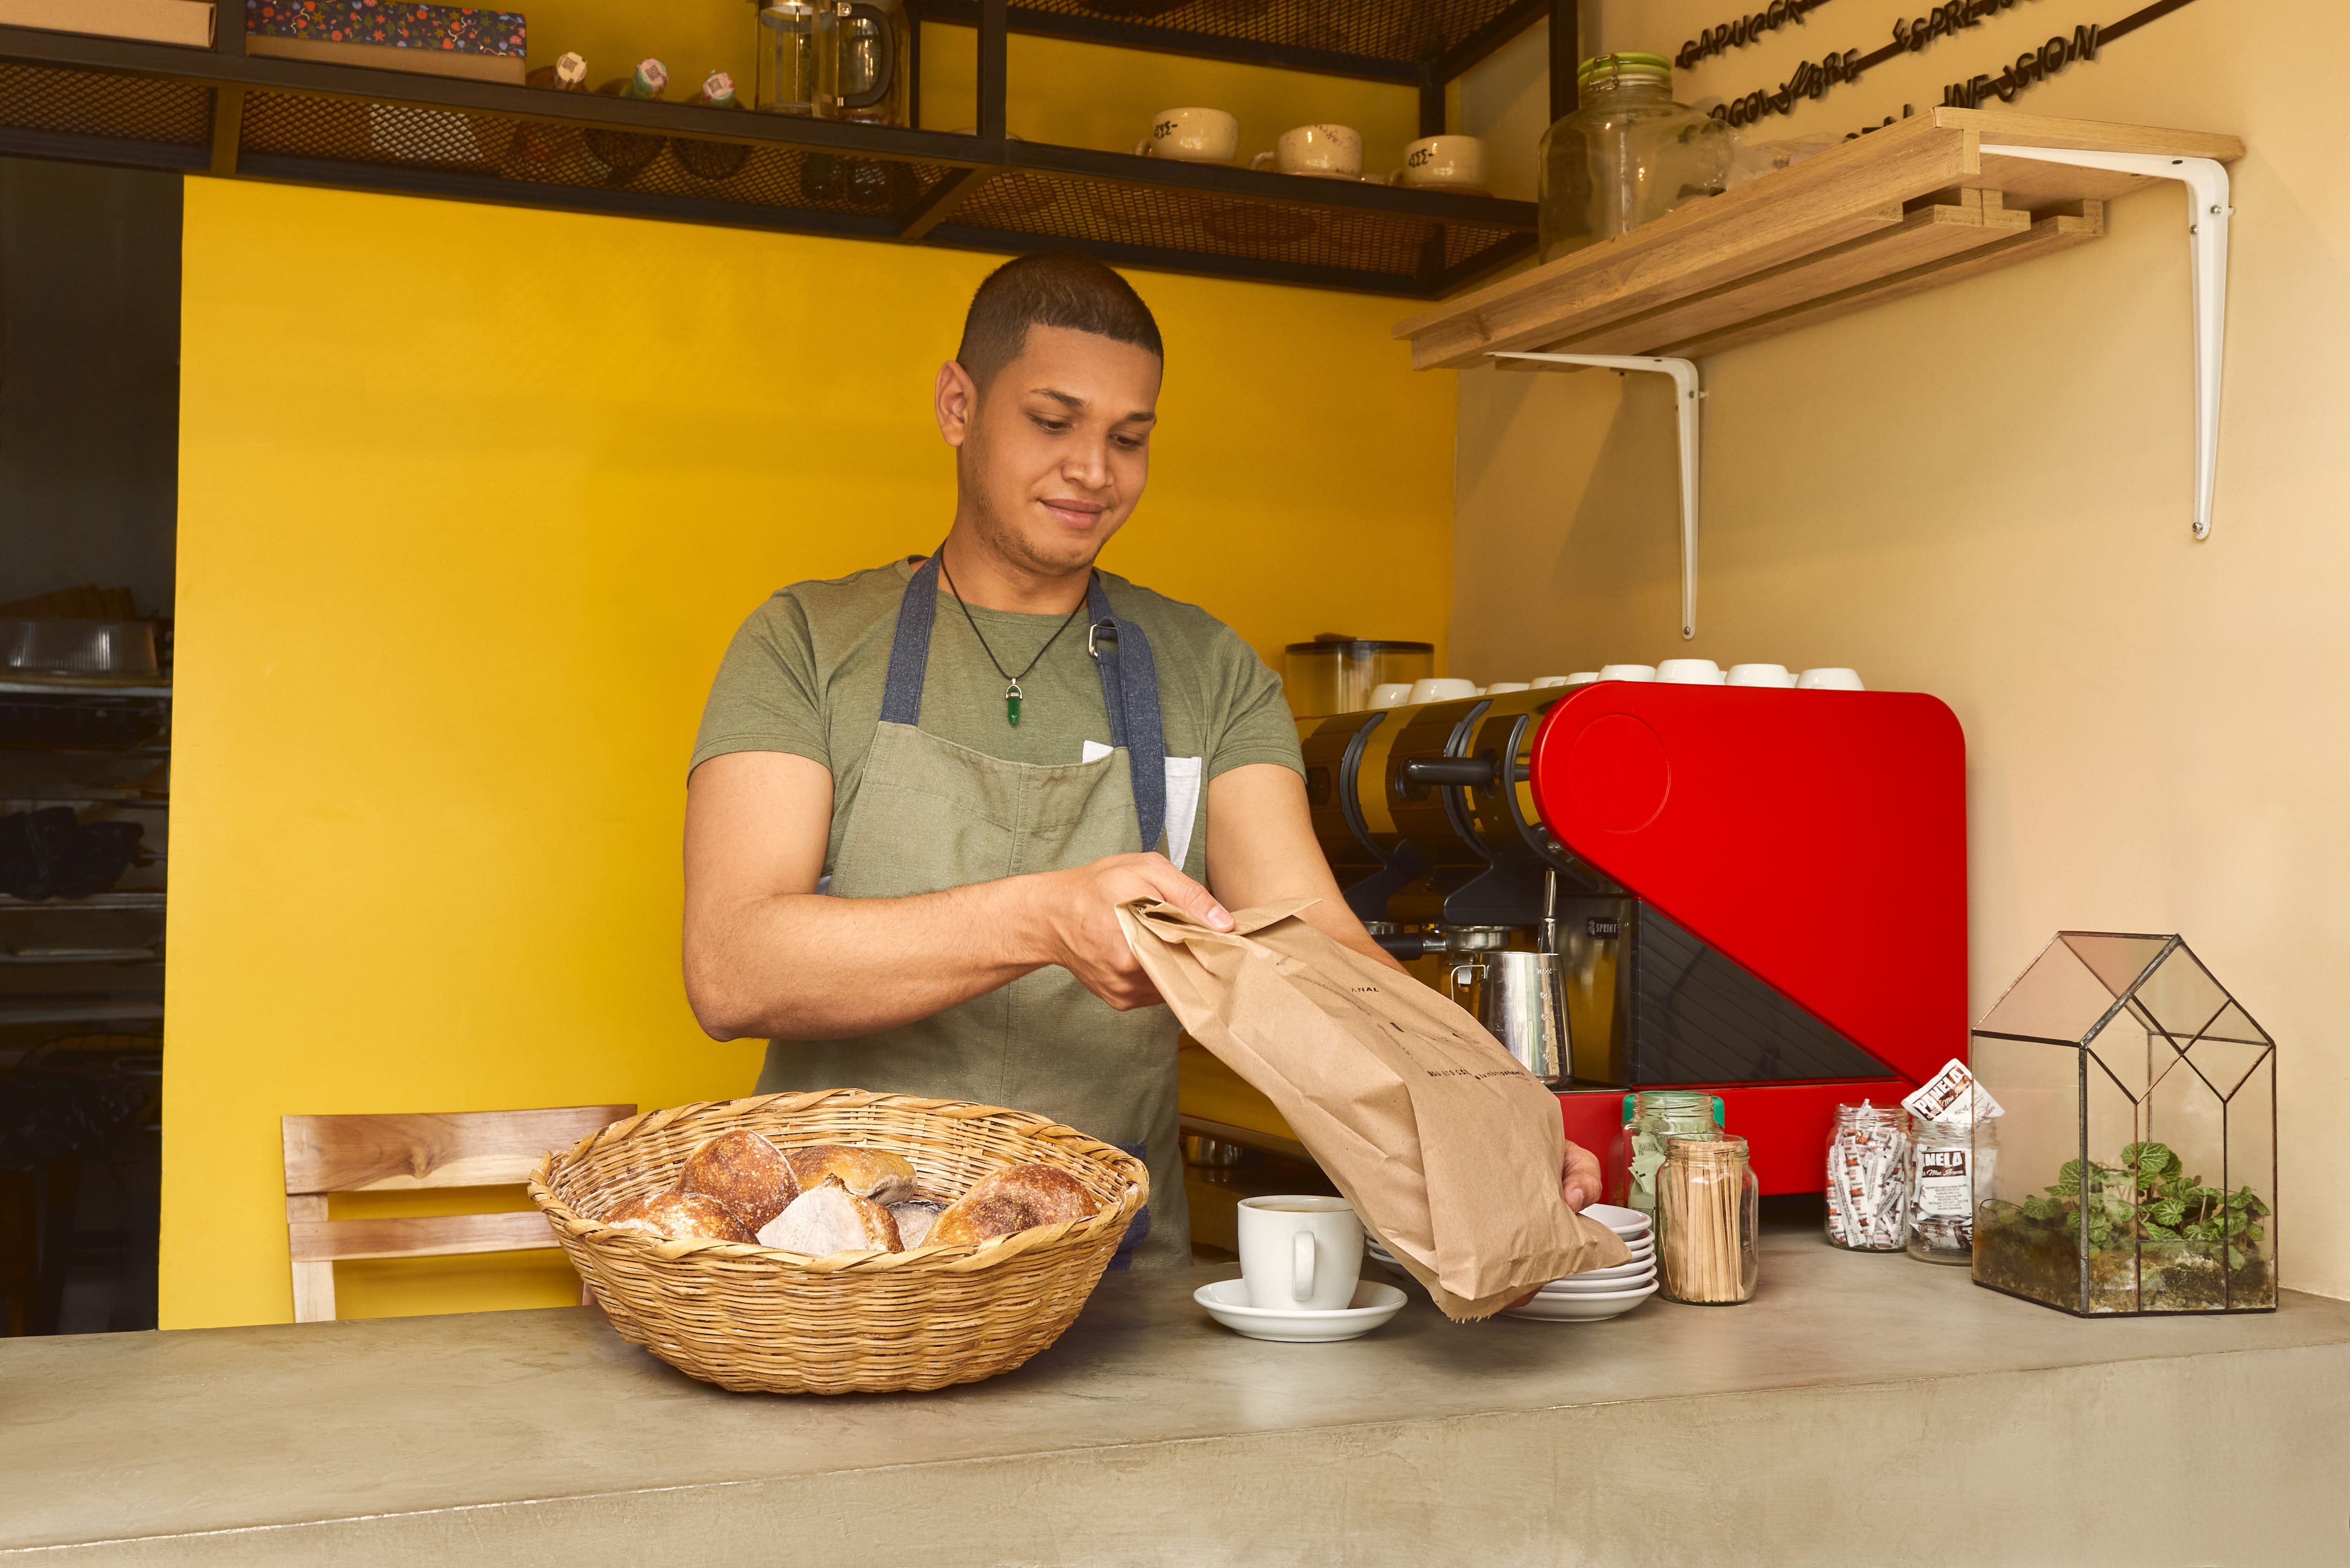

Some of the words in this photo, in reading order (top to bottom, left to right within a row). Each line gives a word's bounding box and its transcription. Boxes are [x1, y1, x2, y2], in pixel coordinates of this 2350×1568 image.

[1944, 24, 2098, 109] INFUSION
[1596, 924, 1617, 933] SPRINT
[1912, 1068, 1964, 1114] PANELA
[1923, 1152, 1963, 1168] NELA
